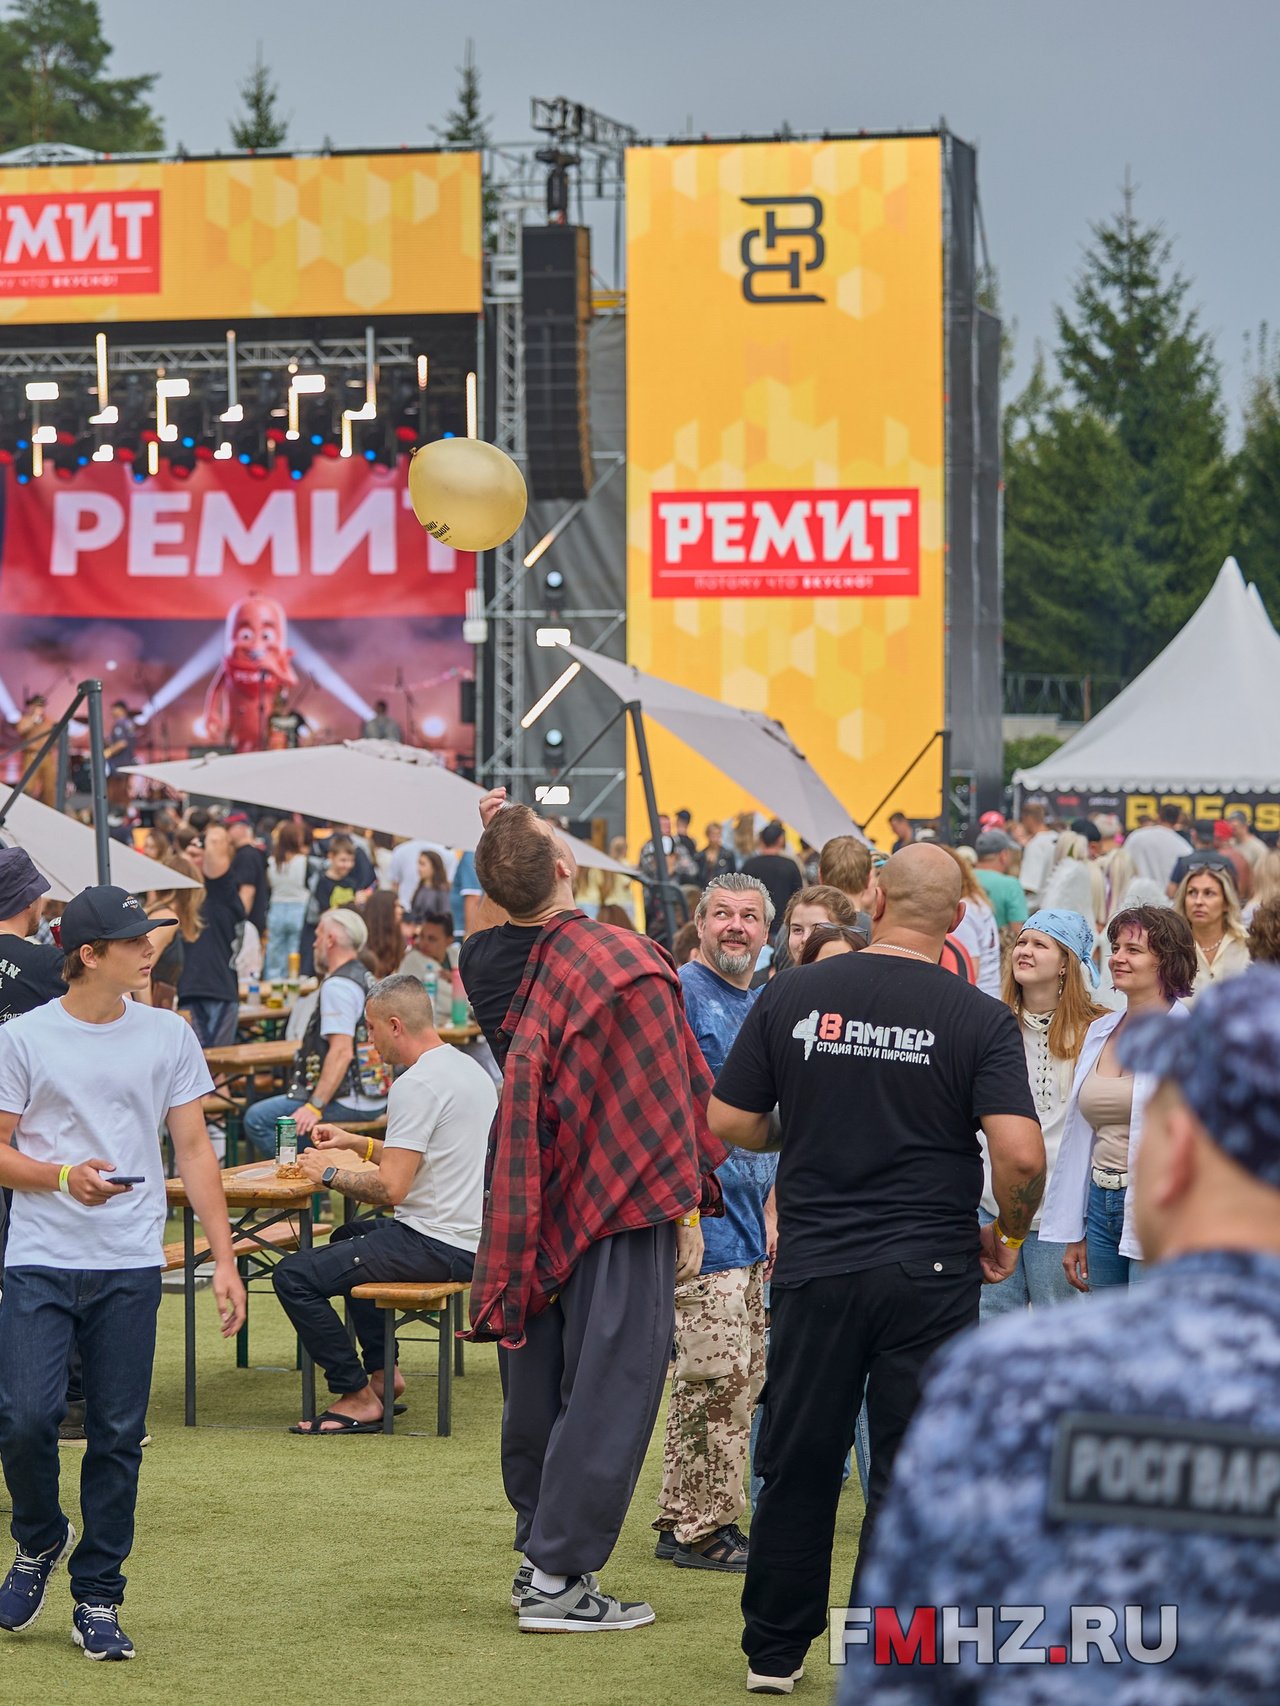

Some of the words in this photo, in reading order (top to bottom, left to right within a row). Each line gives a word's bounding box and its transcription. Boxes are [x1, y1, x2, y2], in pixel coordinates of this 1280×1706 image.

[658, 499, 912, 564] РЕМИТ
[844, 1020, 936, 1051] АМПЕР
[816, 1041, 852, 1056] СТУДИЯ
[853, 1045, 873, 1058] ТАТУ
[881, 1049, 931, 1066] ПИРСИНГА
[1070, 1433, 1280, 1514] РОСГВАР
[519, 1570, 533, 1579] NIKE
